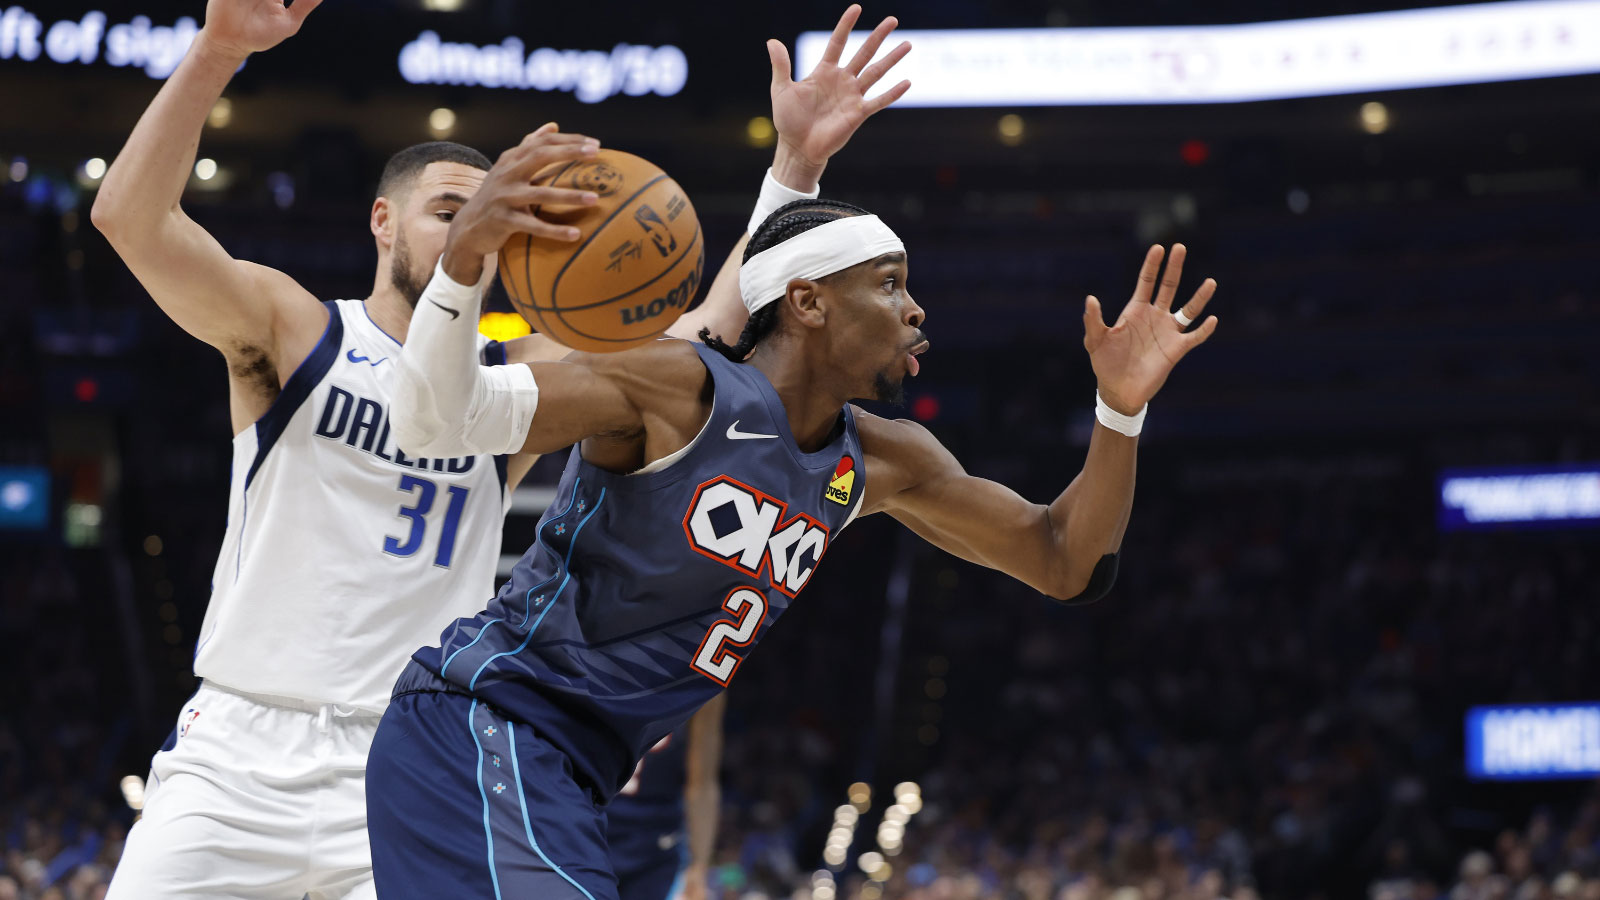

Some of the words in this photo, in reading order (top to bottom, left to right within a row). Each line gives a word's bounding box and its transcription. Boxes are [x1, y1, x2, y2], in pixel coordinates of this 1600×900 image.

[45, 11, 106, 63] of
[105, 15, 248, 79] sig
[398, 31, 688, 103] dmei.org/50
[314, 385, 475, 474] DAL
[383, 474, 470, 569] 31
[683, 475, 829, 598] OKC
[690, 585, 768, 687] 2
